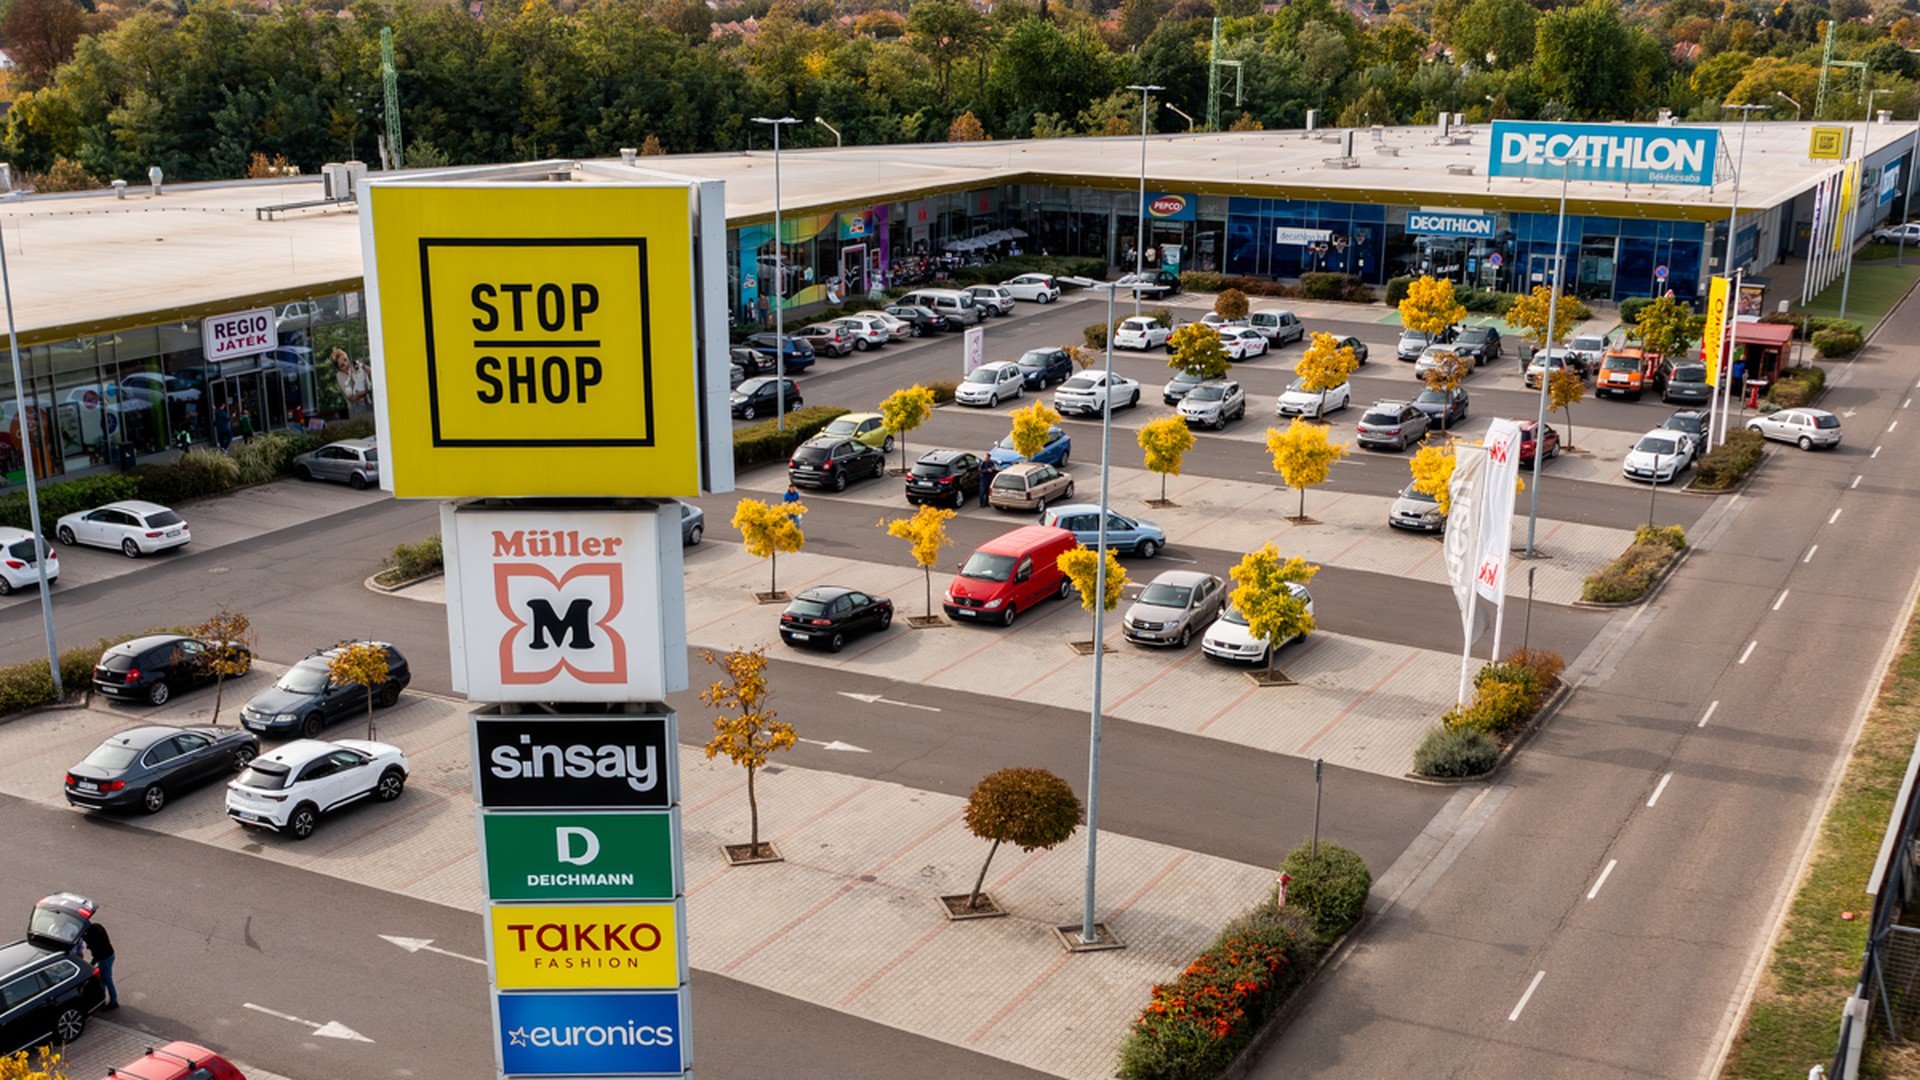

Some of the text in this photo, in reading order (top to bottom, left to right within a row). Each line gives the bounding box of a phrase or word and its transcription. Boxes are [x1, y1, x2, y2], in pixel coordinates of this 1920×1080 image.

[1500, 132, 1705, 172] DECATHLON
[1153, 201, 1181, 212] PEPCO
[1410, 215, 1491, 234] DECATHLON
[471, 283, 599, 332] STOP
[214, 315, 268, 339] REGIO
[216, 333, 268, 353] JÁTÉK
[476, 356, 603, 404] SHOP
[491, 530, 623, 557] Müller
[526, 598, 595, 650] M
[490, 734, 658, 792] sinsay
[556, 826, 600, 866] D
[527, 873, 634, 887] DEICHMANN
[534, 957, 638, 969] FASHION
[530, 1019, 673, 1047] euronics
